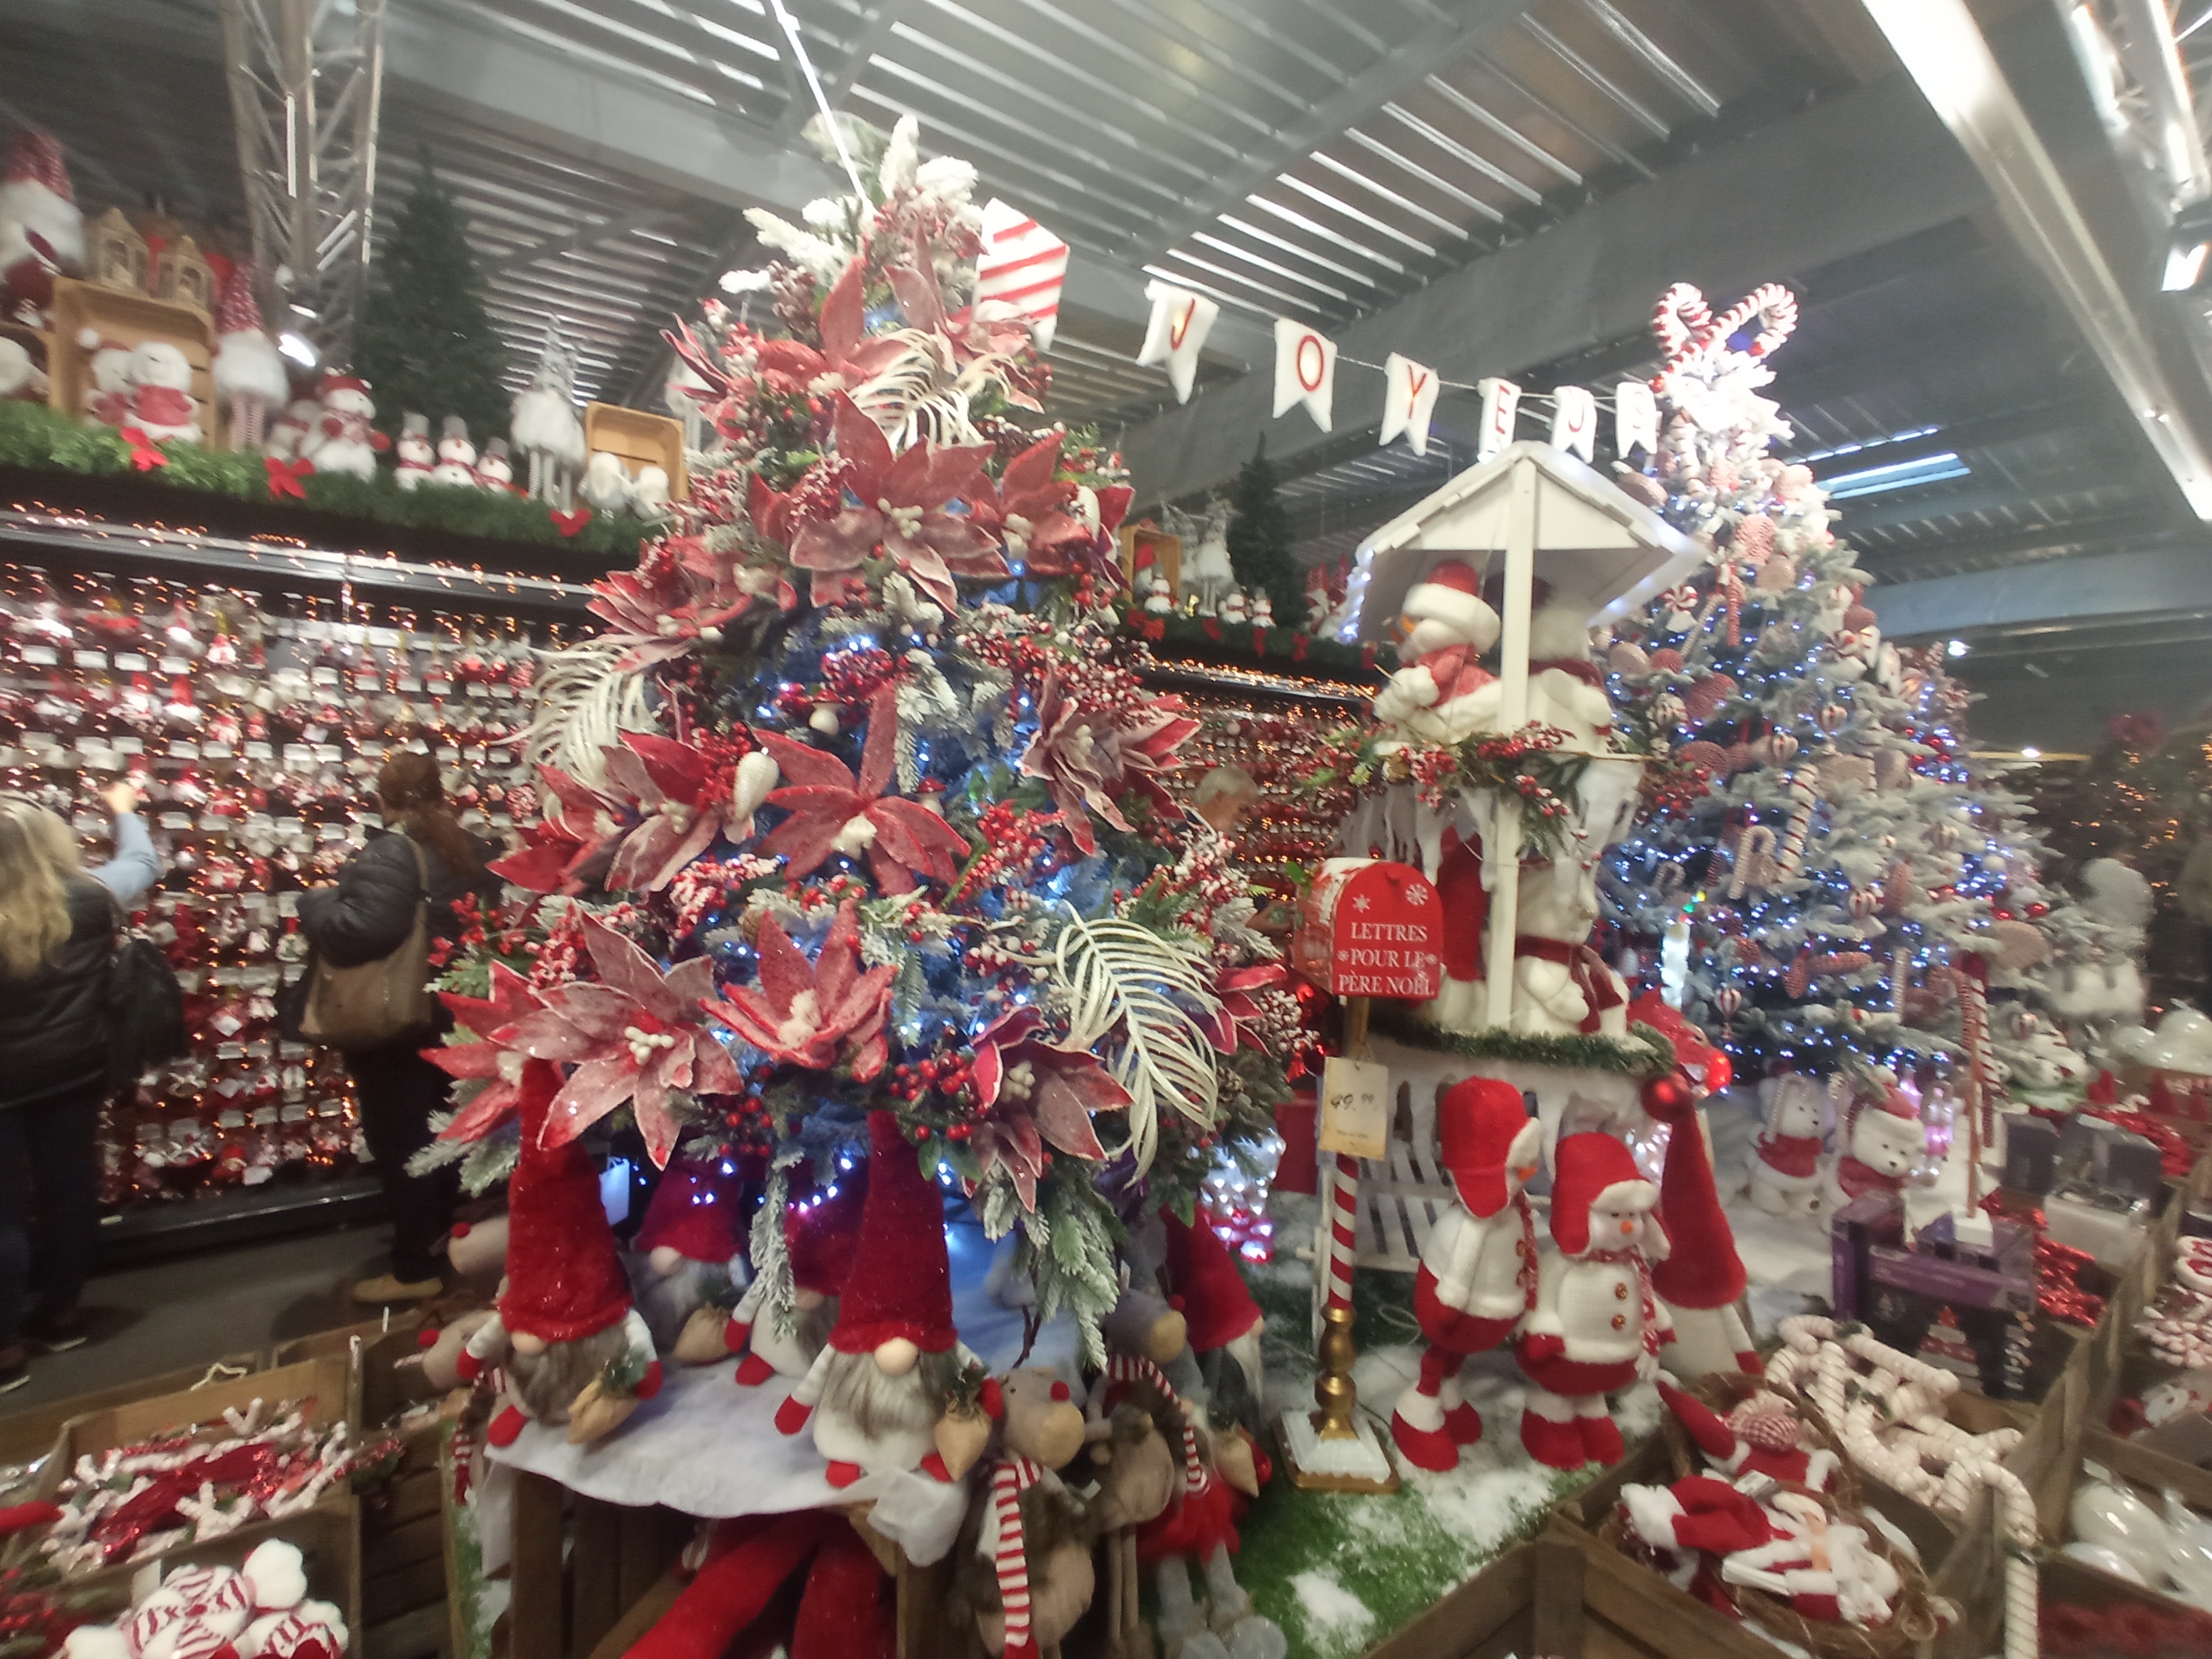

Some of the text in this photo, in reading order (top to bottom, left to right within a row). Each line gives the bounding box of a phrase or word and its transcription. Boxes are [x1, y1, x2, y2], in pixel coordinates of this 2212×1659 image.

[1351, 922, 1428, 942] LETTRES
[1350, 948, 1425, 968] POUR LE
[1338, 970, 1383, 994] PÈRE
